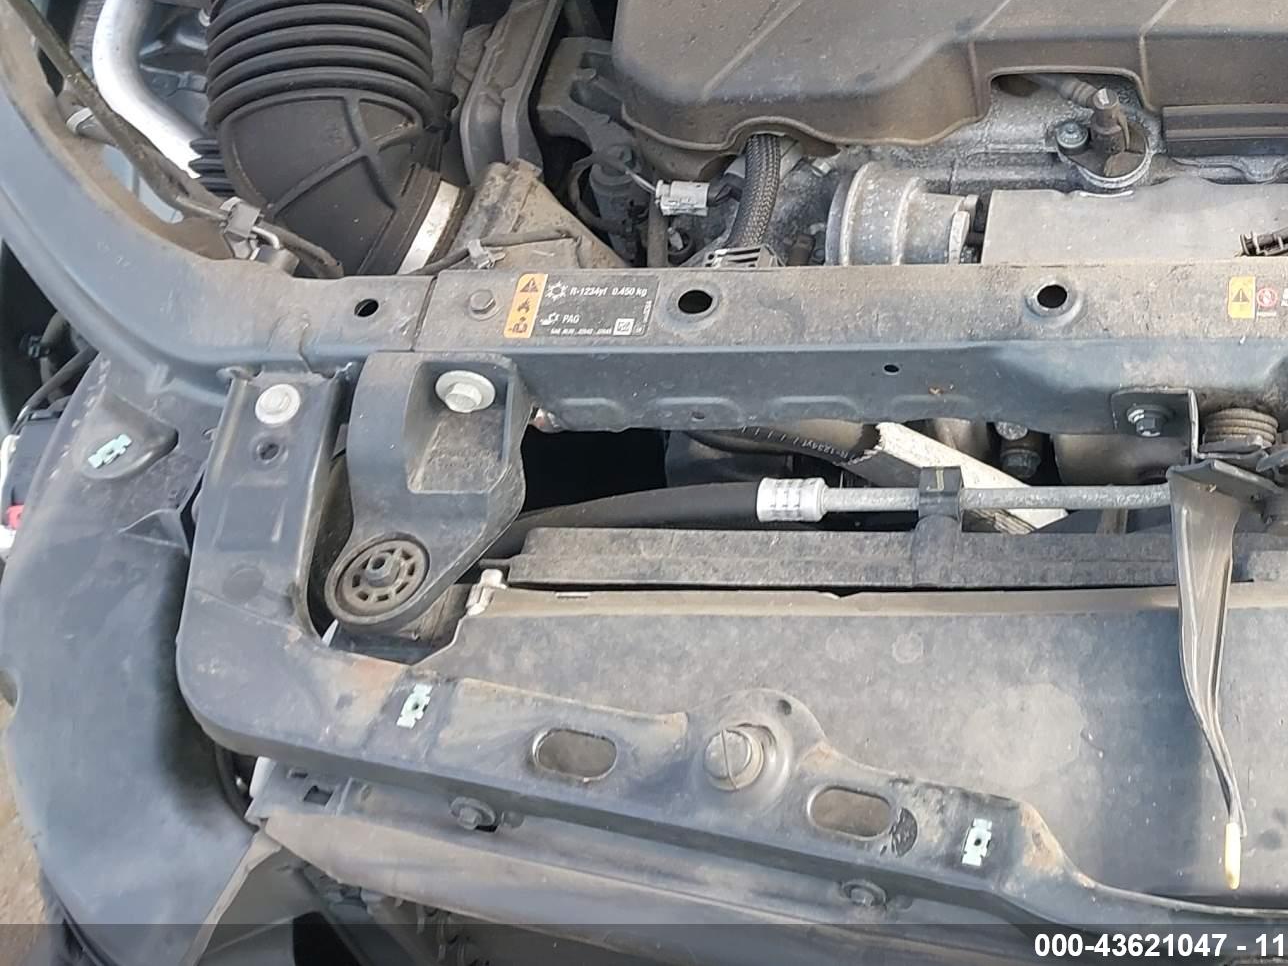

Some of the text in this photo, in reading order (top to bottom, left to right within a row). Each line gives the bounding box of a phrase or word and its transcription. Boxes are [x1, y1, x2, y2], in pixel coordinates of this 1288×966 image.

[569, 286, 648, 298] R-1234yf 0.450 kg
